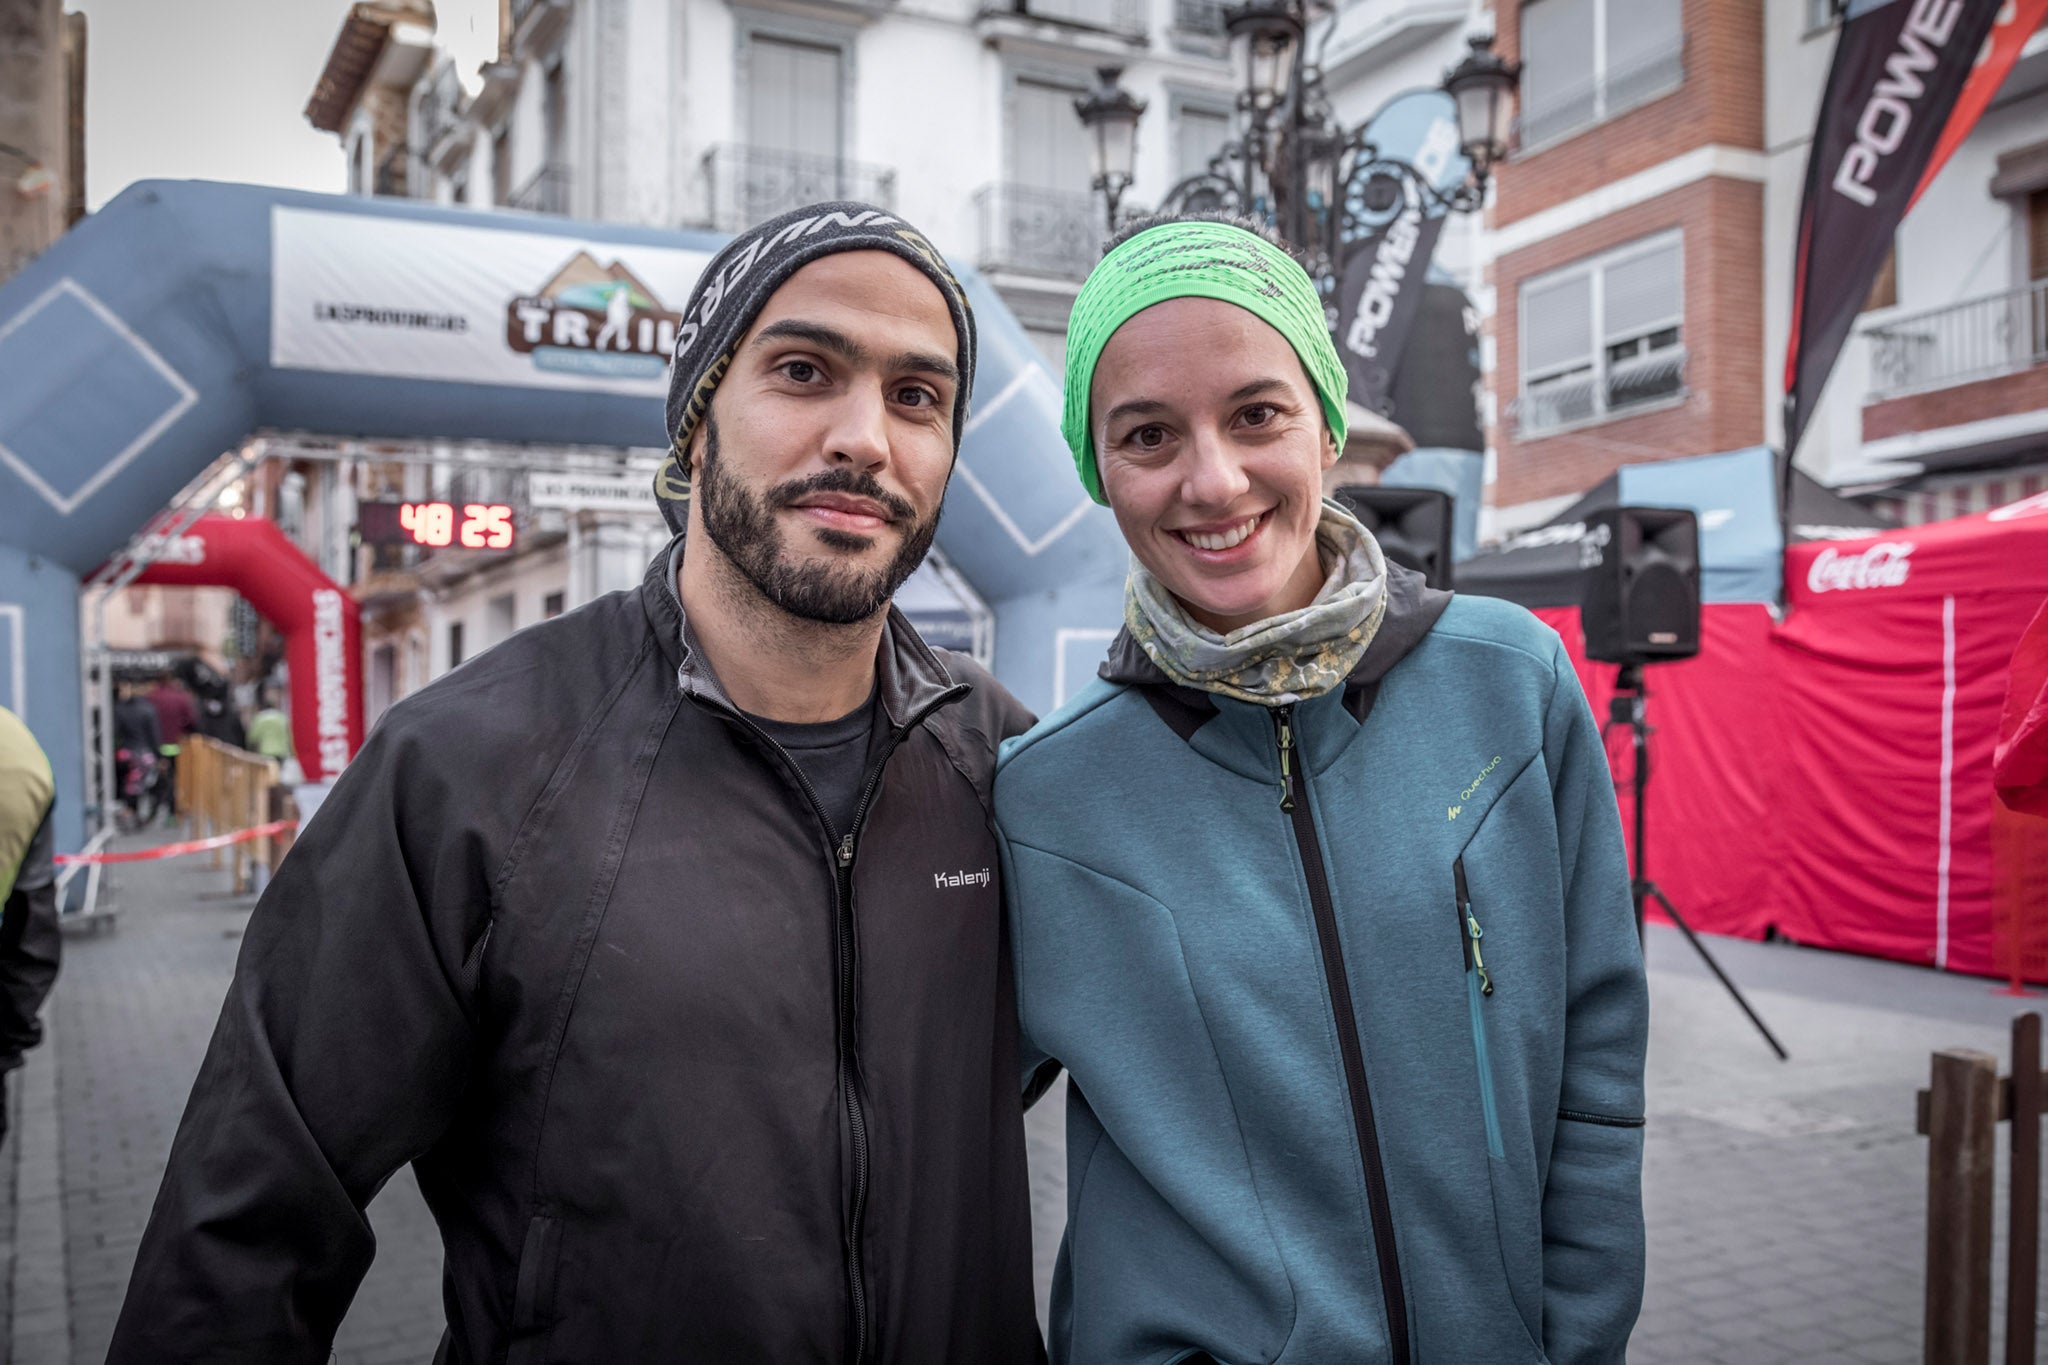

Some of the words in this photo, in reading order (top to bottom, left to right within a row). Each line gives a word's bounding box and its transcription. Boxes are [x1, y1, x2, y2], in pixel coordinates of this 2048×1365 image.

[460, 503, 513, 548] 25
[1461, 755, 1502, 800] Quechua
[934, 867, 990, 889] Kalenji
